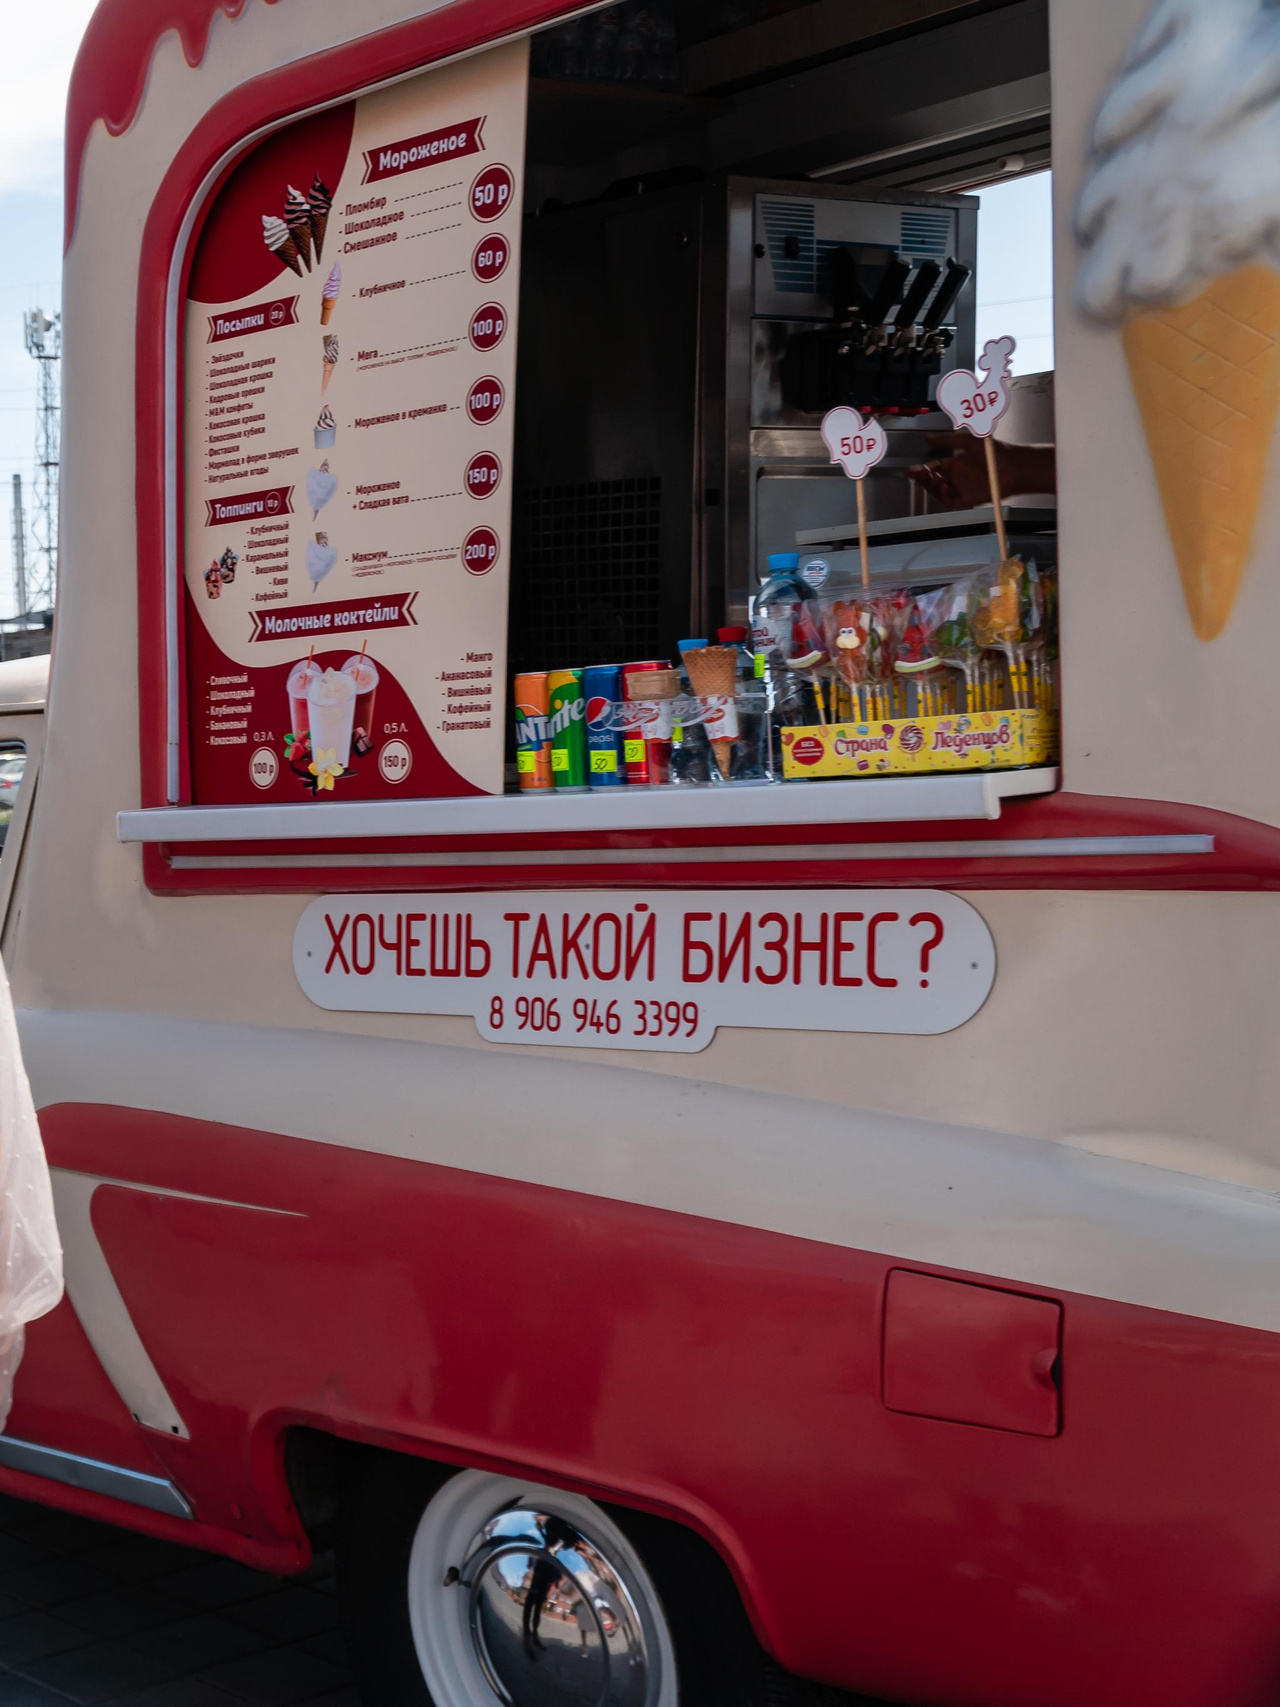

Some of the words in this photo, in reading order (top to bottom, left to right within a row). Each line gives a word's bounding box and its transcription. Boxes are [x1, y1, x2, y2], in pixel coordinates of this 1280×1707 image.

[378, 132, 467, 171] Мороженое
[474, 183, 494, 207] 50
[345, 196, 387, 216] Пломбир
[344, 210, 405, 236] Шоколадное
[343, 231, 398, 254] Смешанное
[477, 250, 493, 268] 60
[358, 279, 407, 299] Клубничное
[216, 313, 265, 335] Посыпки
[472, 319, 493, 337] 100
[357, 350, 379, 362] Мега
[470, 392, 491, 410] 100
[354, 412, 401, 429] Мороженое
[408, 403, 448, 420] креманке
[468, 467, 488, 484] 150
[355, 481, 401, 496] Мороженое
[214, 500, 264, 519] Топпинги
[358, 497, 391, 511] Сладкая
[391, 495, 410, 506] вата
[465, 543, 486, 560] 200
[264, 612, 331, 634] Молочные
[333, 602, 399, 627] коктейли
[466, 652, 493, 664] Манго
[440, 666, 493, 682] Ананасовый
[447, 701, 492, 716] Кофейный
[441, 717, 492, 733] Гранатовый
[833, 737, 888, 758] Страна
[930, 723, 1010, 754] Леденцов
[253, 762, 268, 775] 100
[383, 755, 399, 769] 150
[594, 757, 608, 770] 50
[324, 912, 491, 979] ХОЧЕШЬ
[504, 902, 657, 983] ТАКОЙ
[681, 911, 944, 989] БИЗНЕС?
[489, 995, 504, 1030] 8
[514, 996, 561, 1033] 906
[572, 997, 621, 1035] 946
[633, 999, 699, 1038] 3399
